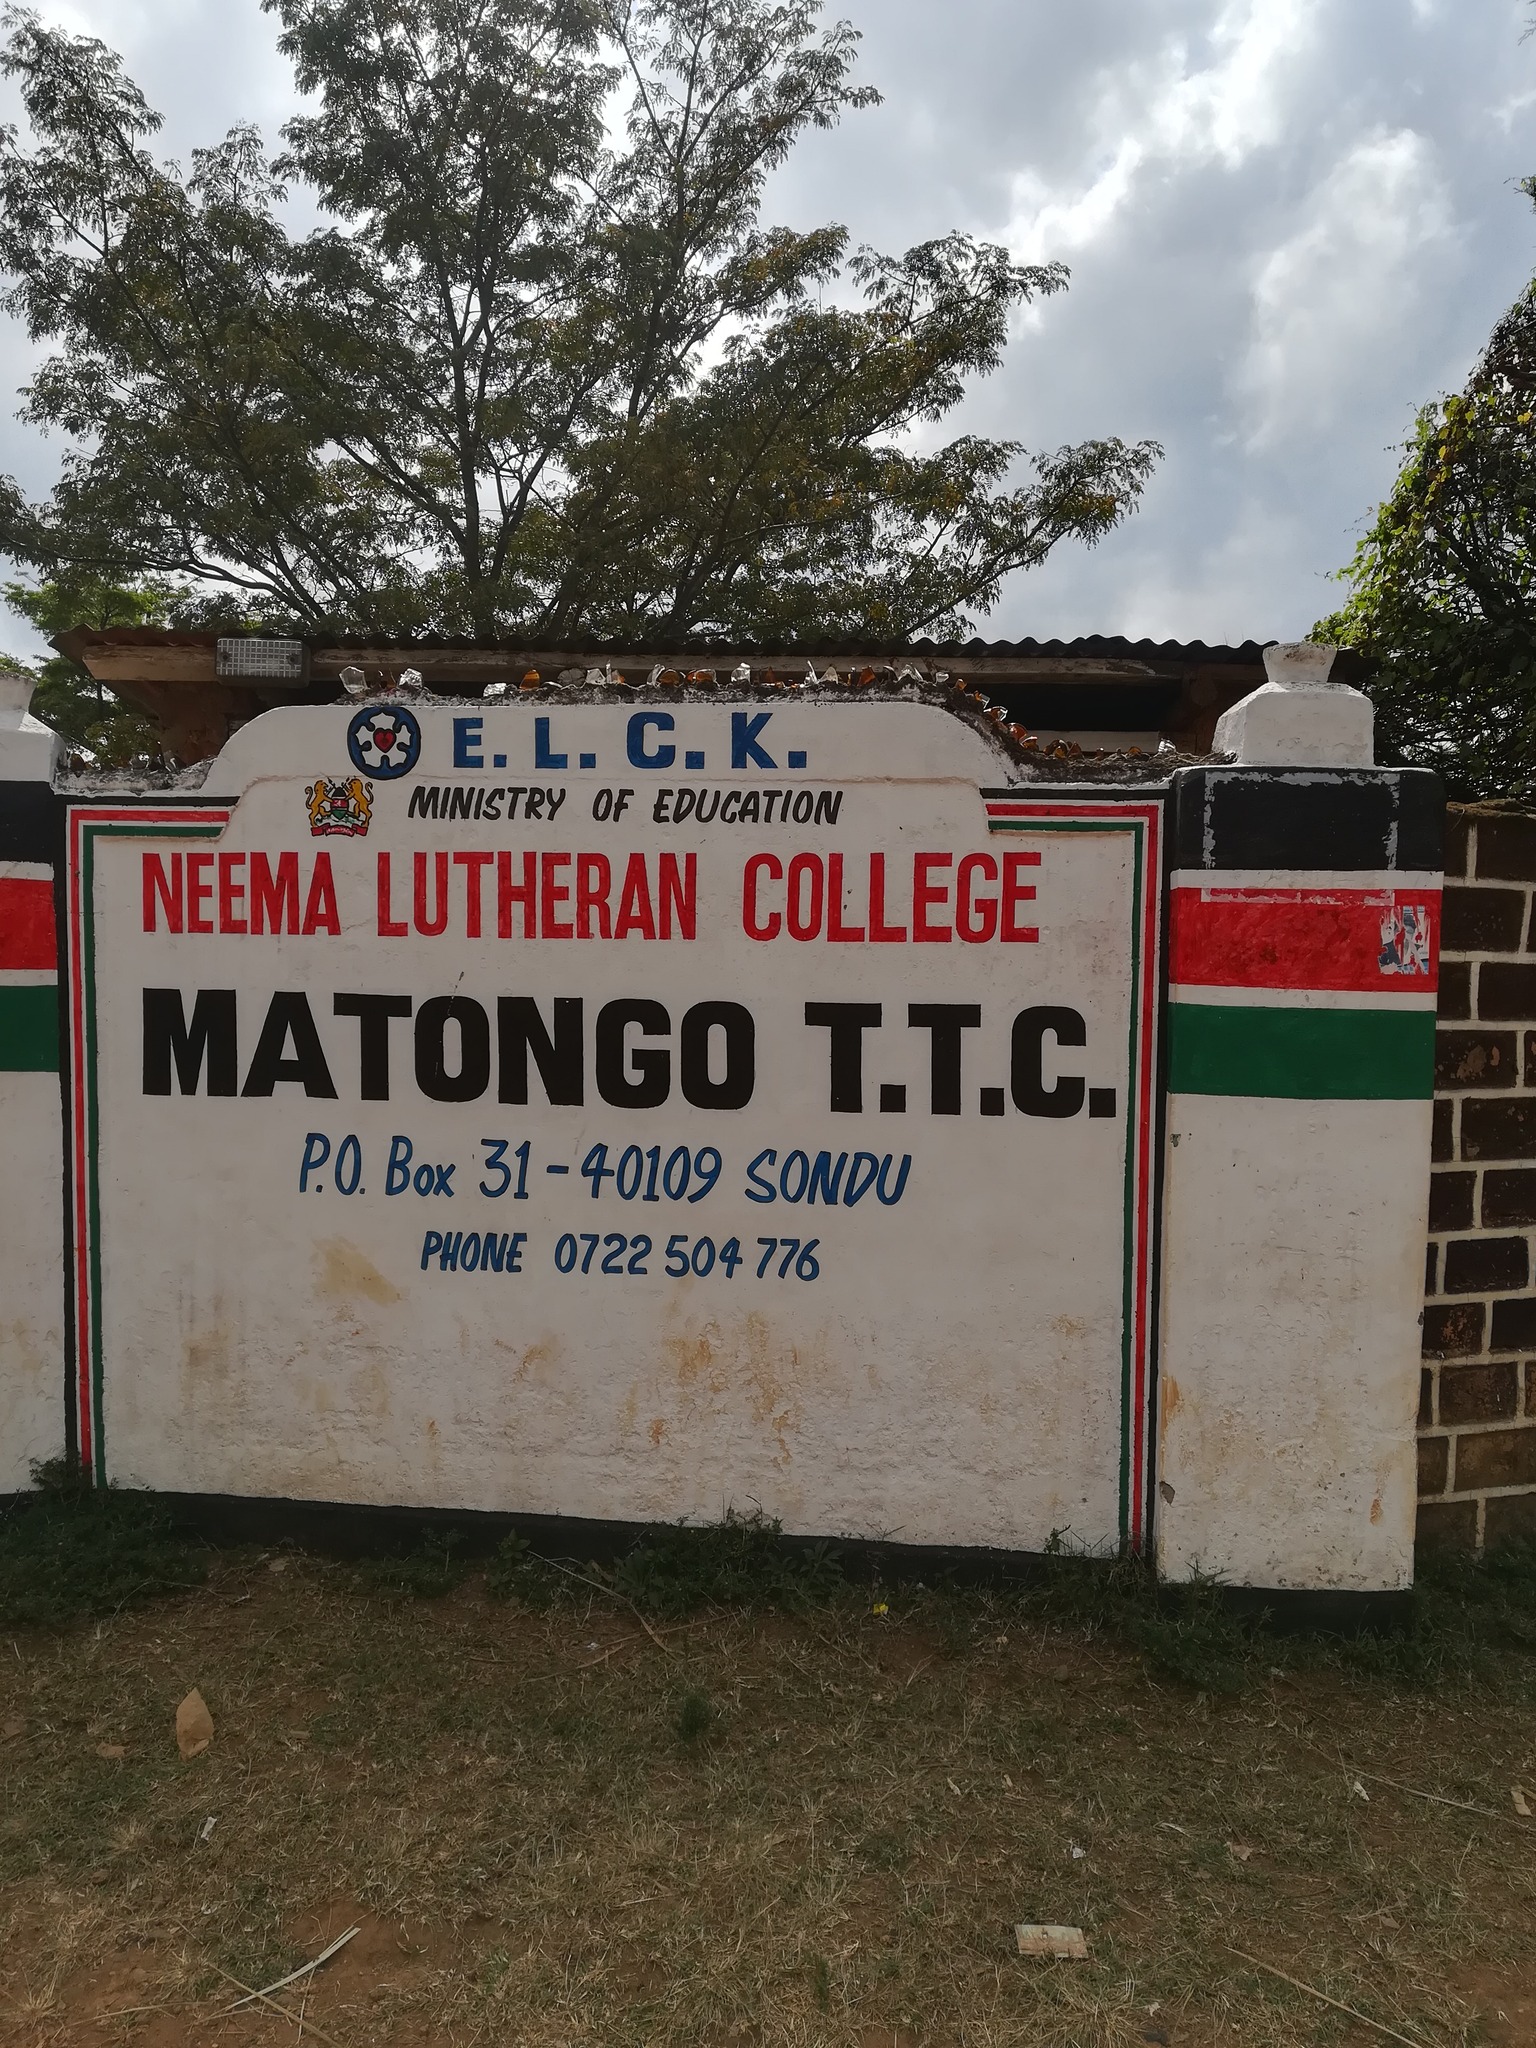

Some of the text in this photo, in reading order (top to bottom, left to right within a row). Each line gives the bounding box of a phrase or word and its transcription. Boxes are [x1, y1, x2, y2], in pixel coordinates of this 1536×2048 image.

[407, 786, 843, 825] MINISTRY OF EDUCATION
[142, 851, 1042, 943] NEEMA LUTHERAN COLLEGE
[142, 987, 1117, 1119] MATONGO T.T.C.
[299, 1132, 366, 1196] P.O.
[385, 1135, 456, 1197] Box
[744, 1148, 912, 1208] SONDU
[420, 1230, 821, 1282] PHONE 0722 504 776
